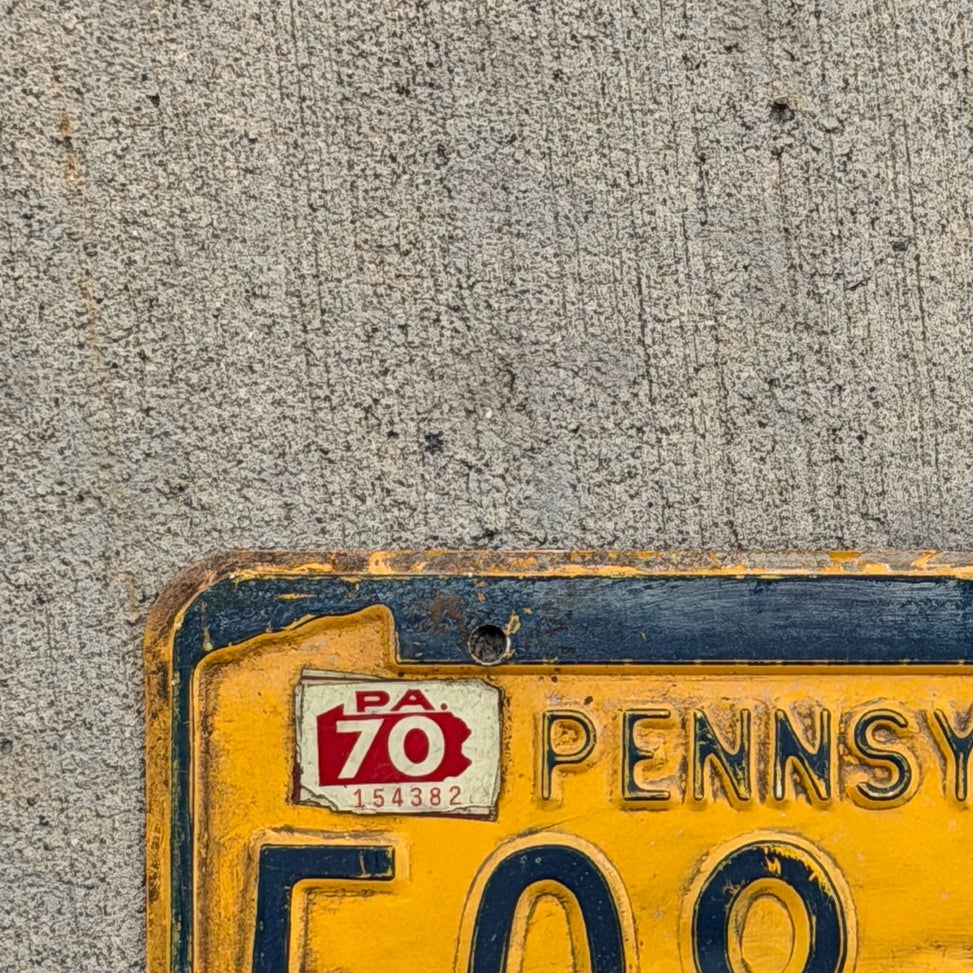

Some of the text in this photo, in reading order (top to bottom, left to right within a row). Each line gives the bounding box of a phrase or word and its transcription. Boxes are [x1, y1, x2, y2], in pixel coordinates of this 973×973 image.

[355, 689, 448, 713] PA.
[335, 715, 446, 780] 70
[353, 785, 463, 809] 154382
